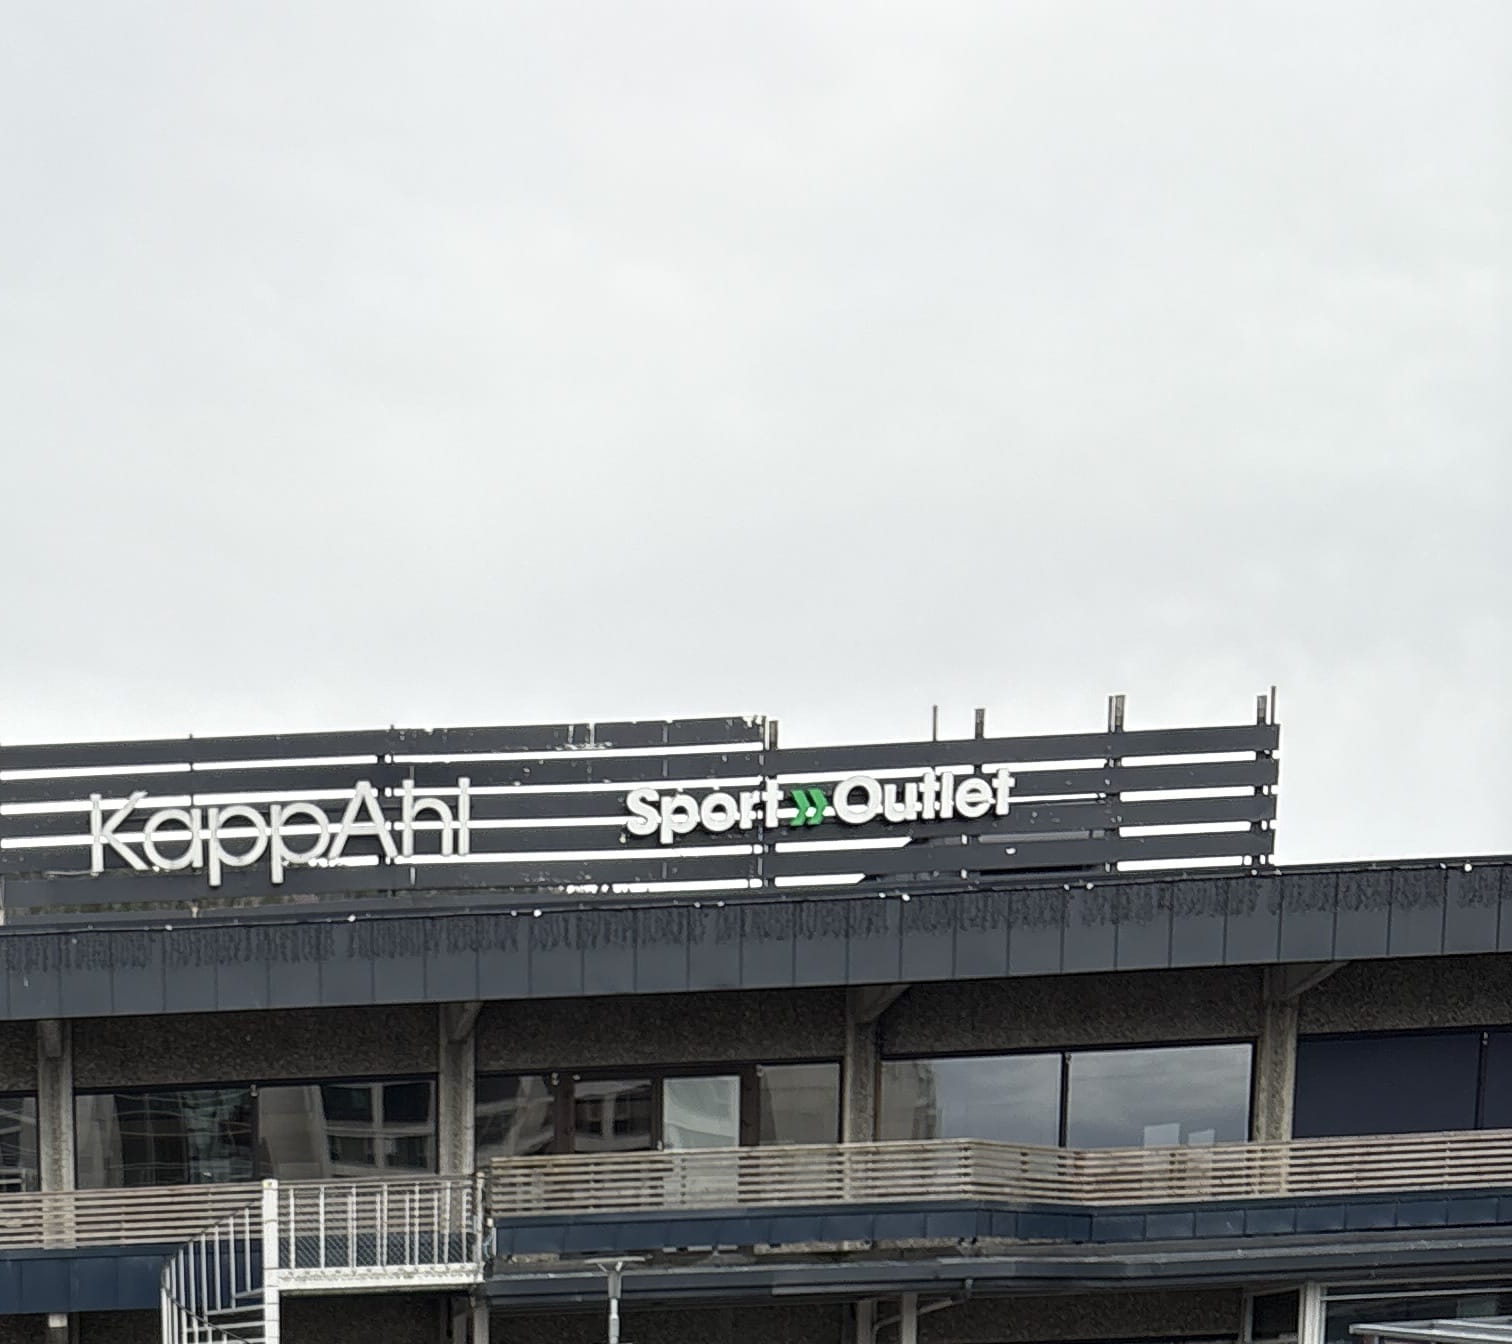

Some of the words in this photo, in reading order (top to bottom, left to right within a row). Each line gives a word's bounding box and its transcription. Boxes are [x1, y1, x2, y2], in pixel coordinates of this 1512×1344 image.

[90, 776, 471, 887] KappAhl
[625, 784, 783, 845] Sport
[833, 768, 1015, 825] Outlet
